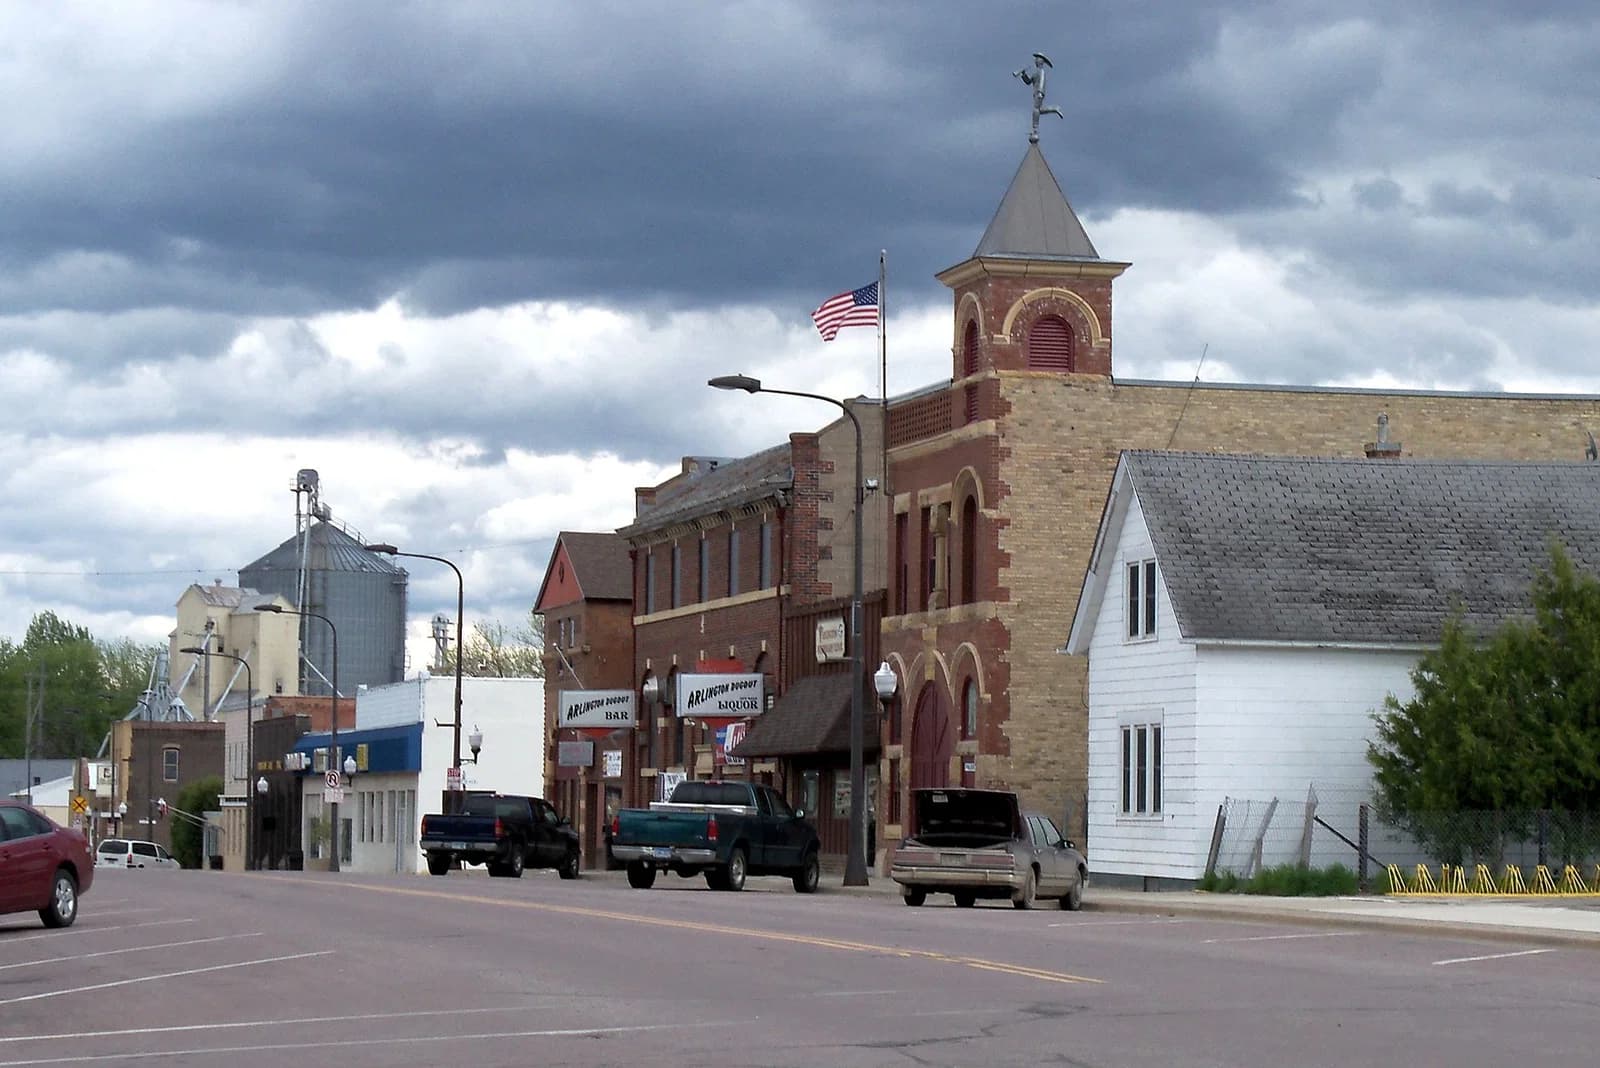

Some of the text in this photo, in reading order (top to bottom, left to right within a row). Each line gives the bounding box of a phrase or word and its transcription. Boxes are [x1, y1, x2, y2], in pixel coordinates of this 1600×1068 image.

[687, 680, 758, 709] ARLINGTON DUGOUT
[567, 696, 629, 721] ARLINGTON DUGOUT
[718, 700, 758, 712] LIQUOR
[605, 711, 629, 720] BAR
